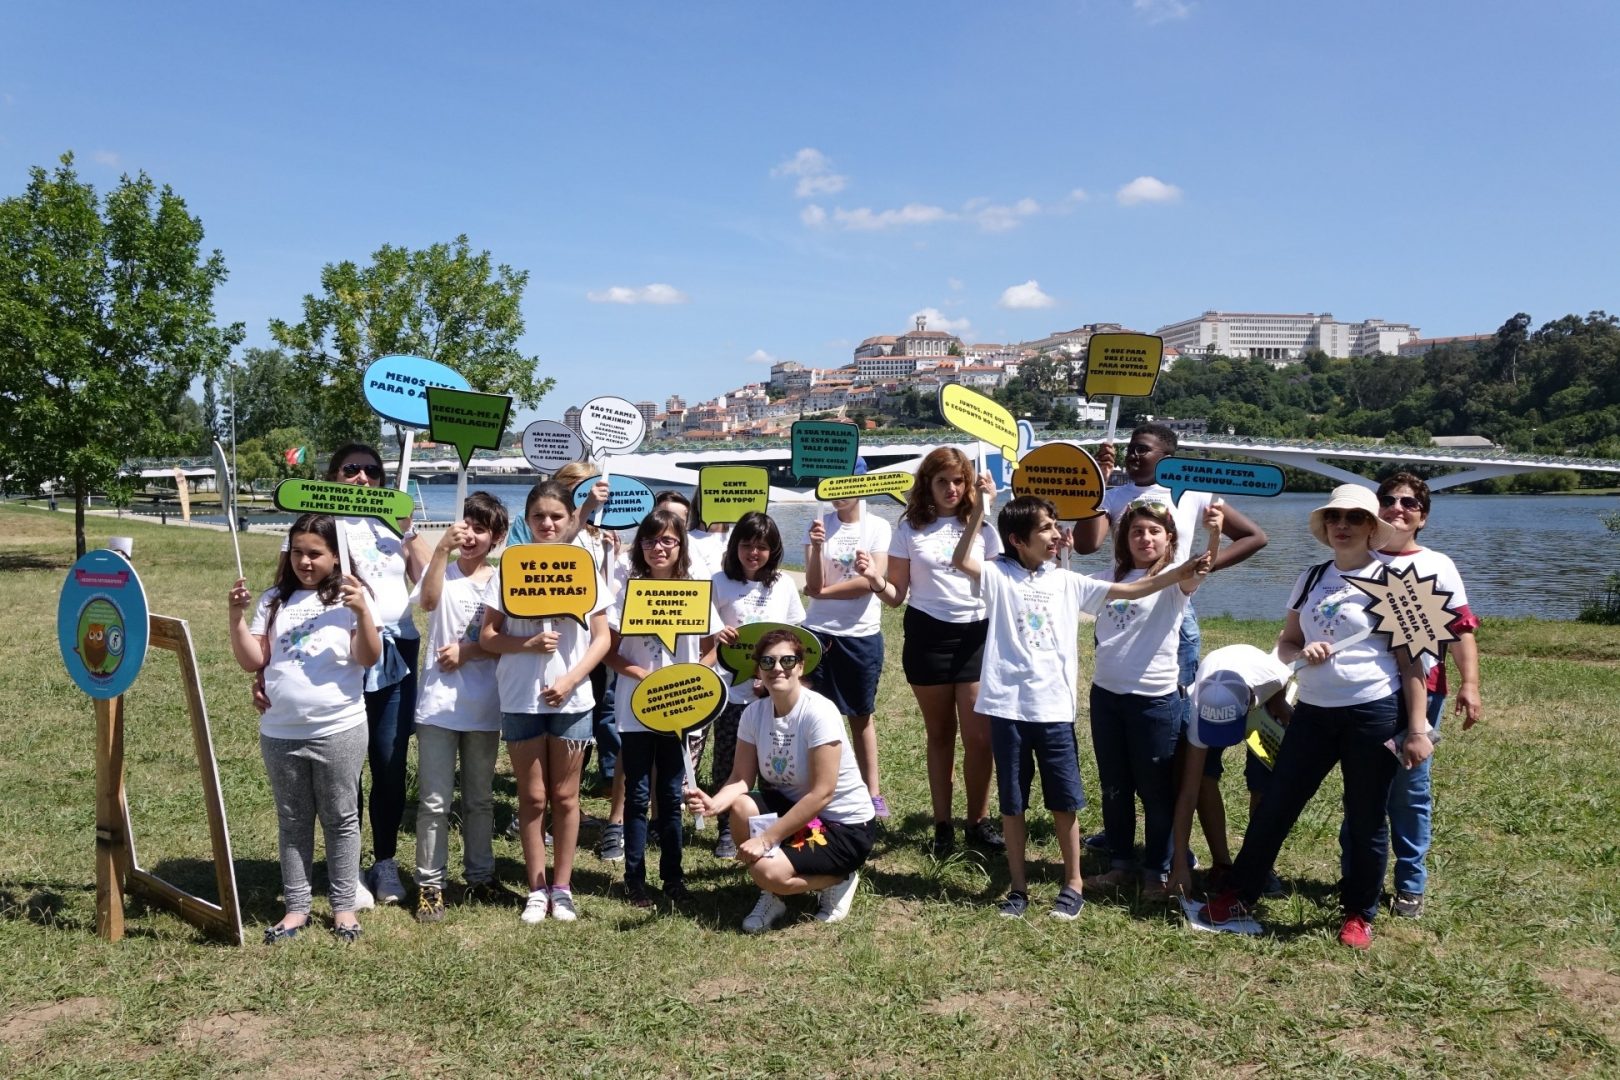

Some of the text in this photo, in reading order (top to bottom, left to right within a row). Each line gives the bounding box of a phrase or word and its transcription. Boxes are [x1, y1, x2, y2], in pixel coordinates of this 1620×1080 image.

[386, 371, 426, 387] MENOS
[370, 380, 404, 395] PARA
[432, 405, 491, 418] RECICLA-ME
[614, 410, 636, 419] ARMES
[951, 404, 982, 420] ECOPONTO
[434, 415, 499, 429] EMBALAGEM!
[1025, 466, 1079, 474] MONSTROS
[1161, 472, 1181, 480] NÃO
[1182, 465, 1213, 474] SUJAR
[1226, 468, 1254, 477] FESTA
[1028, 477, 1086, 486] MONOS SÃO
[301, 484, 354, 495] MONSTROS
[367, 490, 395, 498] SOLTA
[1035, 487, 1099, 498] COMPANHIA!
[301, 501, 335, 510] FILMES
[351, 505, 393, 514] TERROR!
[370, 498, 383, 506] EM
[521, 560, 536, 570] VÊ
[525, 575, 573, 583] DEIXAS
[510, 586, 586, 596] PARA TRÁS!
[1399, 596, 1420, 632] SÓ CRIA
[1403, 580, 1418, 602] LIXO
[1419, 613, 1436, 641] SOLTA
[1386, 592, 1414, 643] CONFUSÃO!
[647, 676, 701, 695] ABANDONADO
[641, 691, 714, 714] CONTAMINO ÁGUAS
[648, 695, 662, 704] SOU
[670, 705, 695, 715] SOLOS.
[1201, 704, 1236, 720] GIANTS
